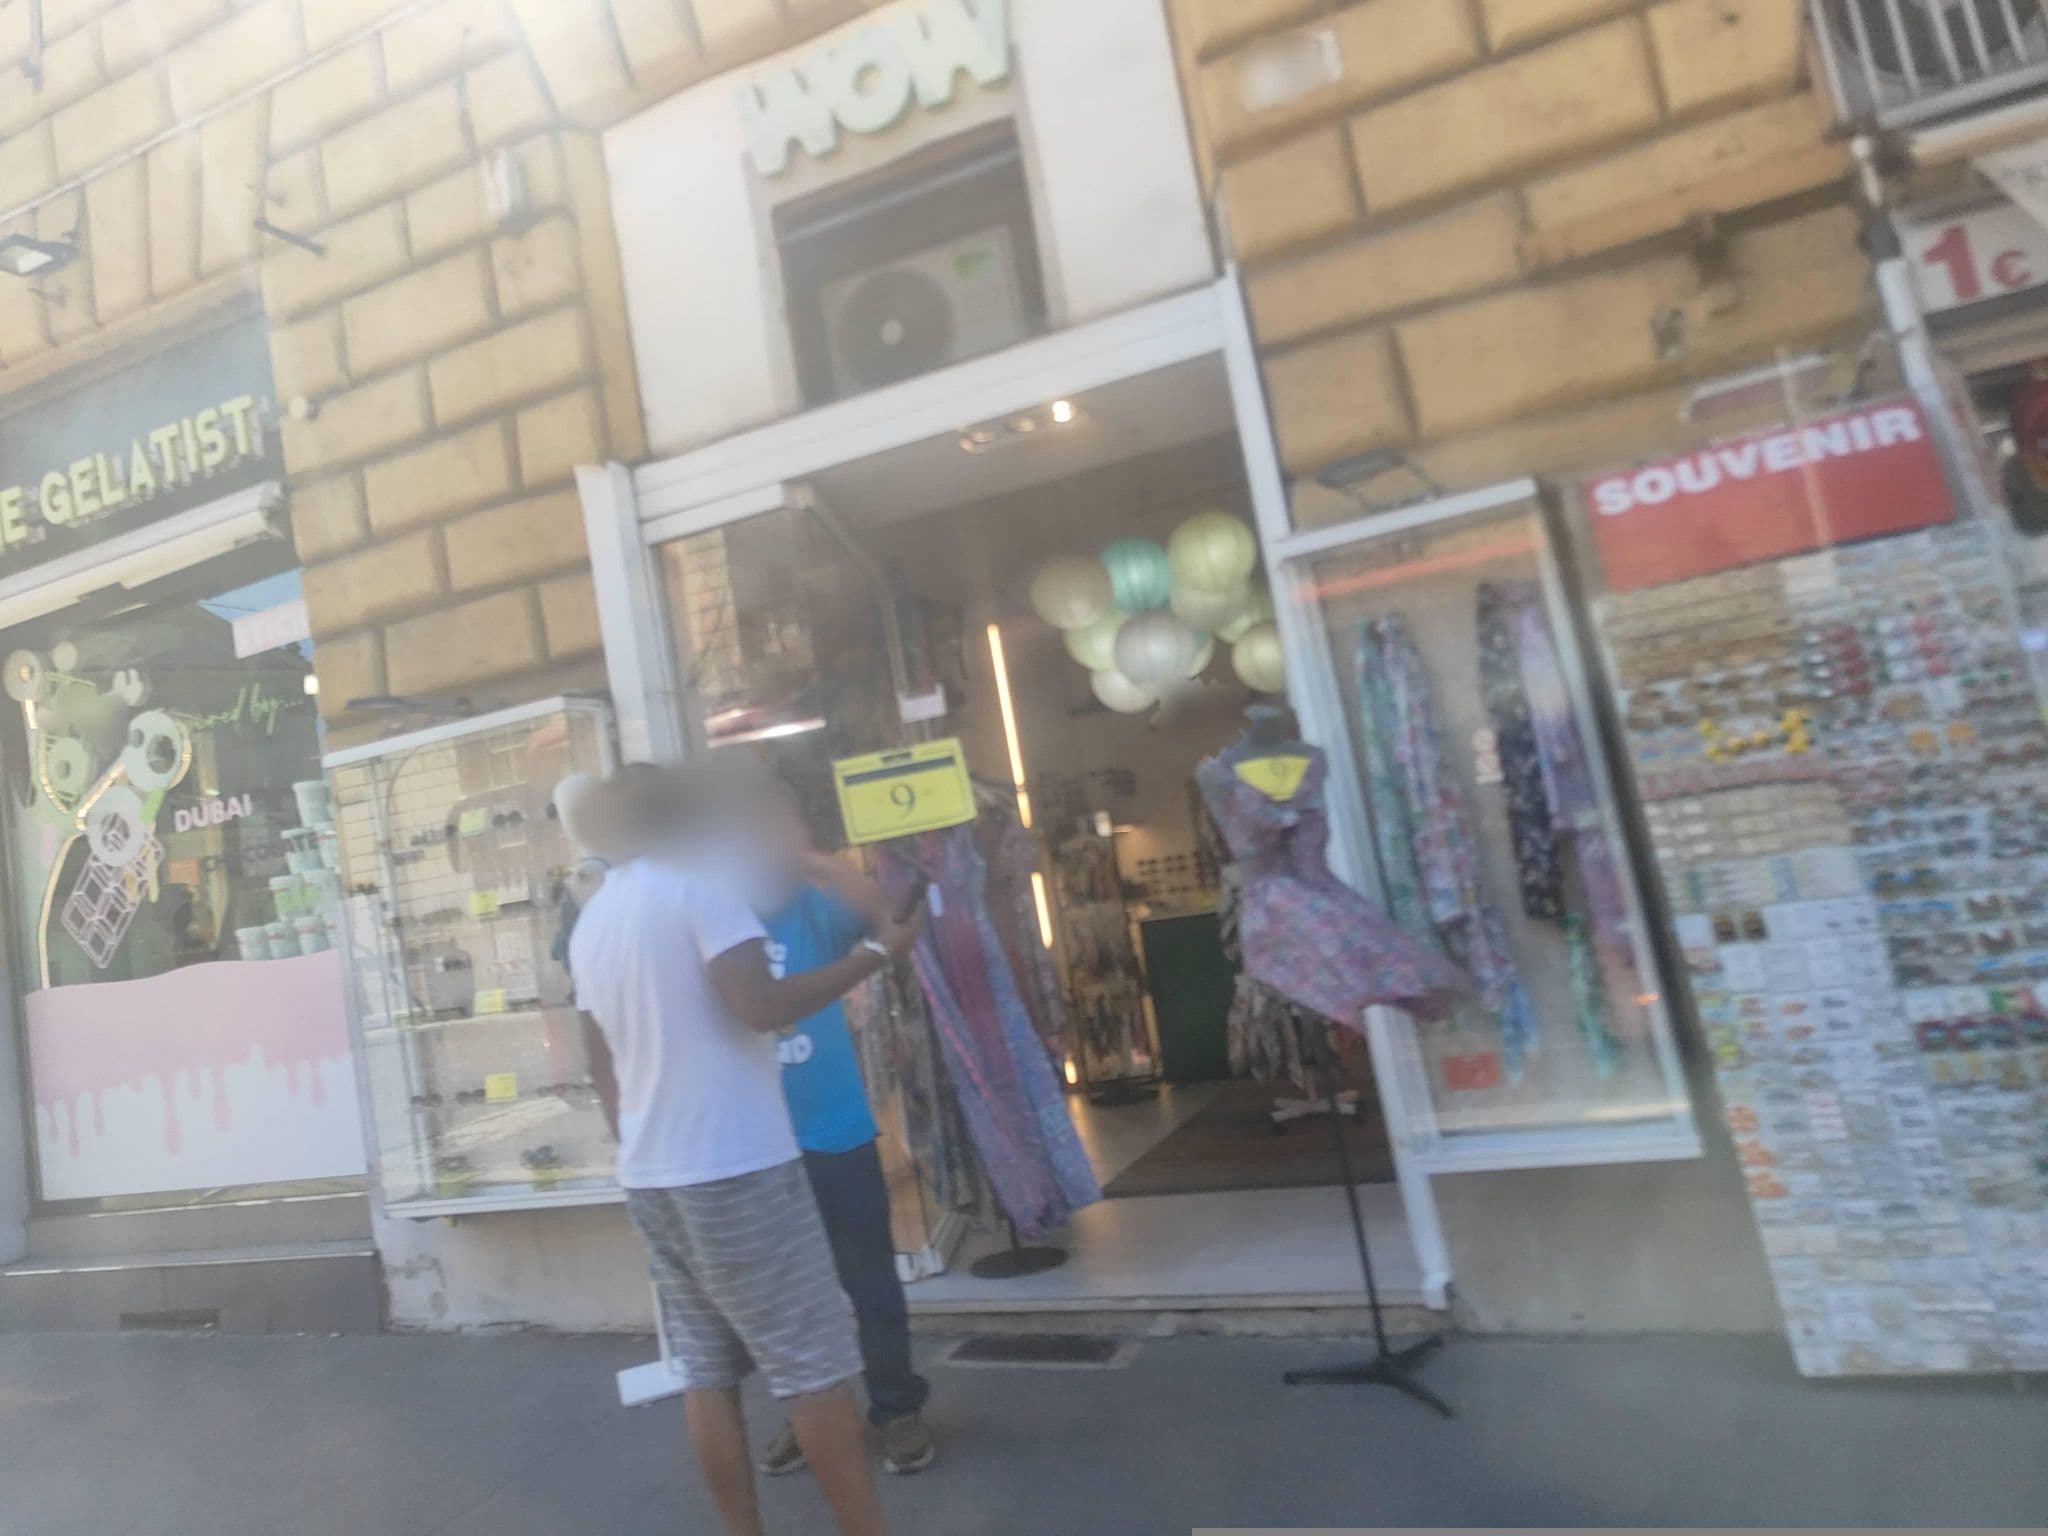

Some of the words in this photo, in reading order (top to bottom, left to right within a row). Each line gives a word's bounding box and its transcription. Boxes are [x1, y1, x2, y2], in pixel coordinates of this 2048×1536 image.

[733, 0, 1008, 178] WOW
[1593, 407, 1922, 515] SOUVENIR
[174, 793, 252, 832] DUBAI
[889, 783, 916, 818] 9
